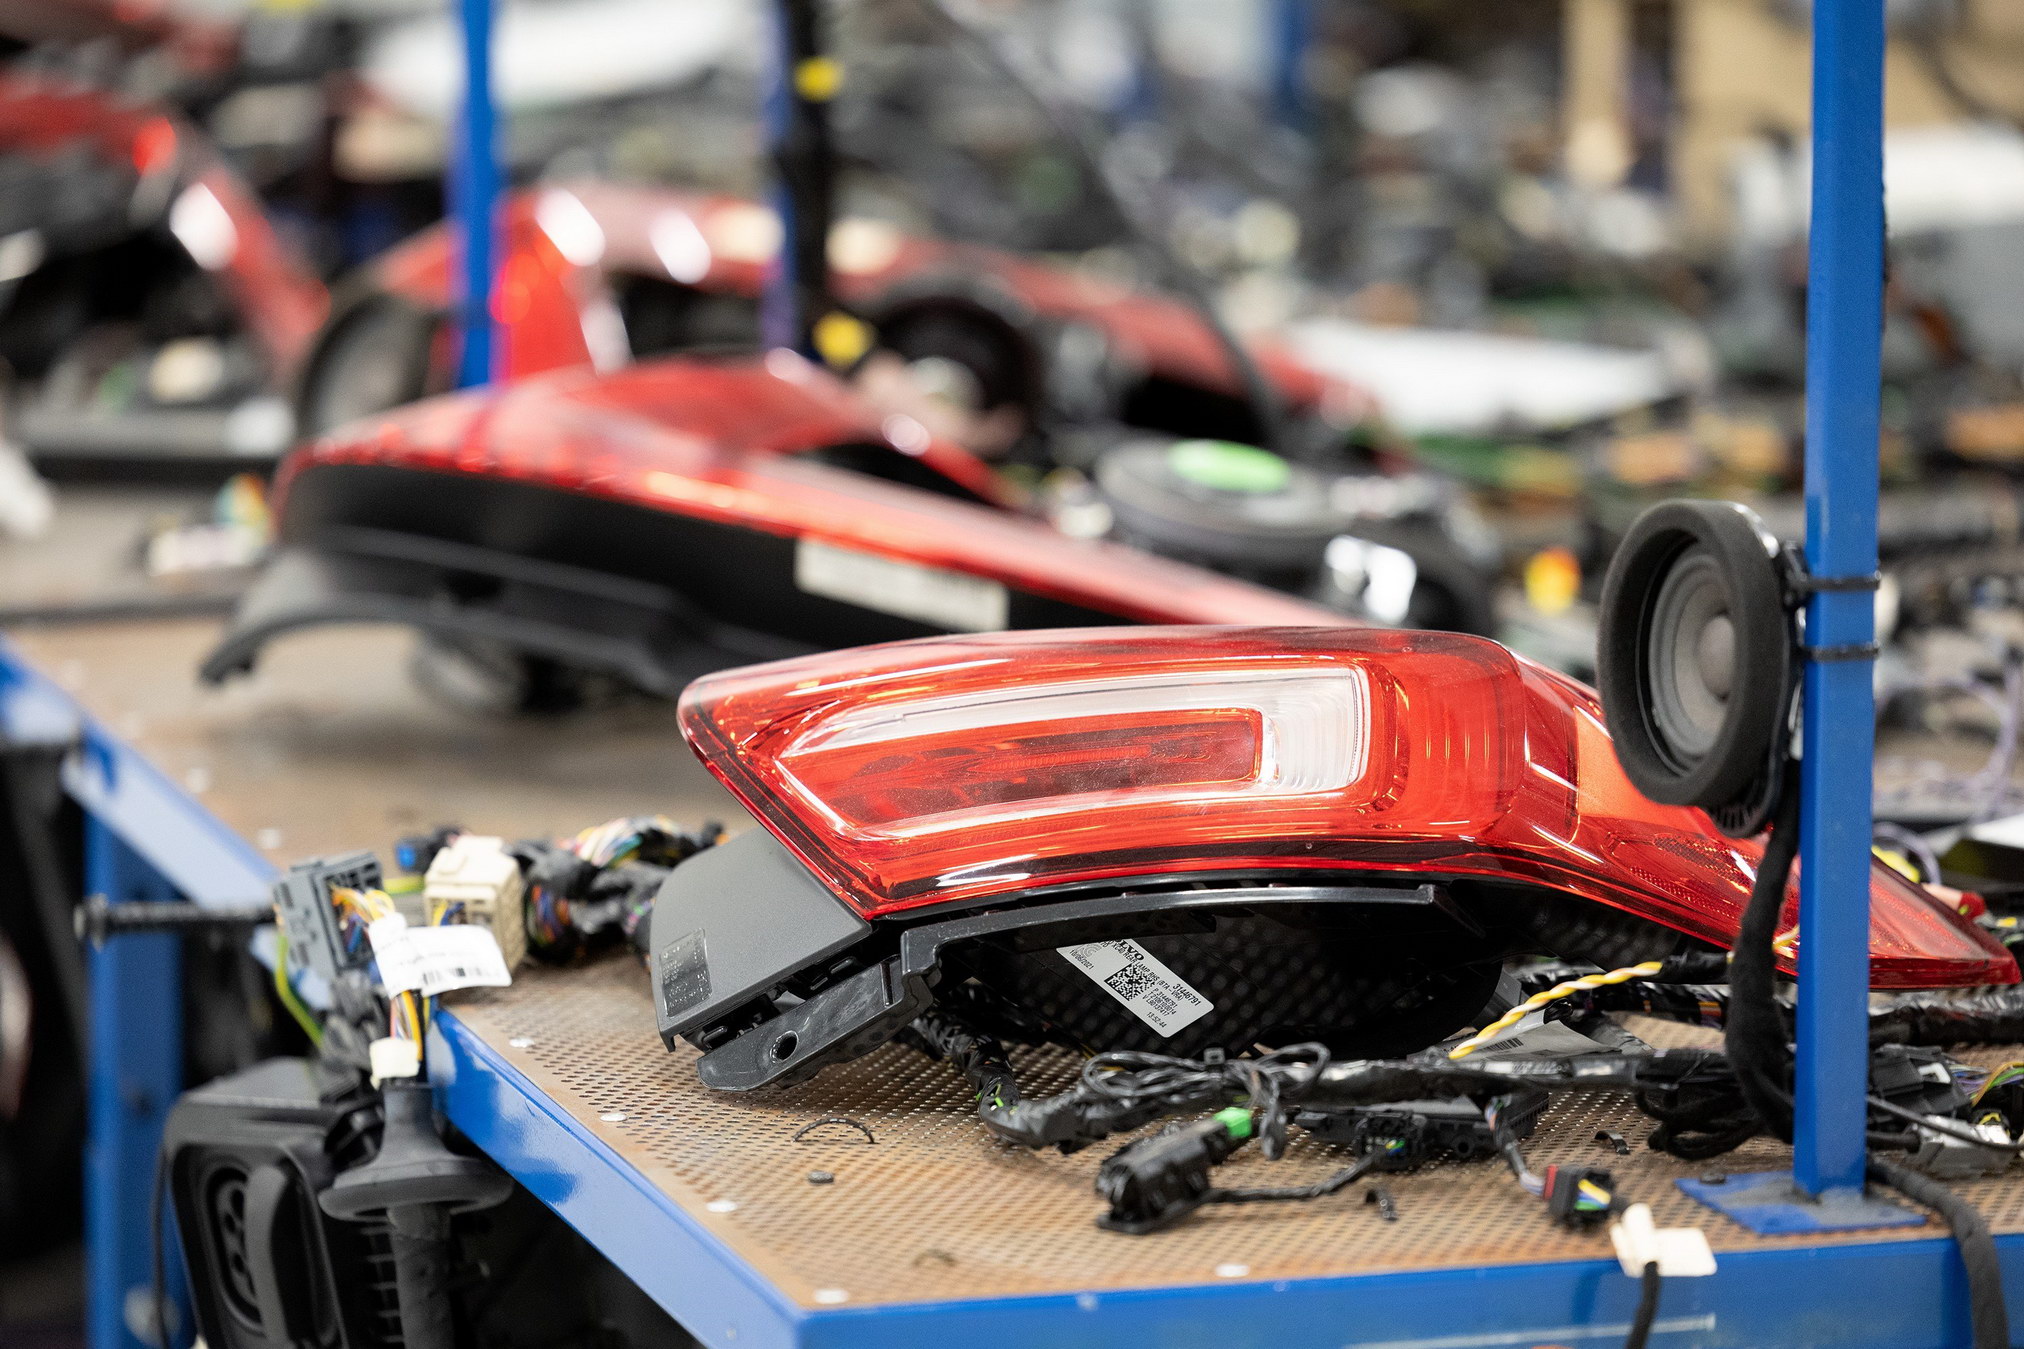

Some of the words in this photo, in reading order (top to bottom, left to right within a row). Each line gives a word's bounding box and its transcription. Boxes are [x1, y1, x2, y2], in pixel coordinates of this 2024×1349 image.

[1069, 949, 1094, 971] 10/06/2021
[1135, 962, 1151, 973] LAMP
[1172, 983, 1201, 1006] 31446791
